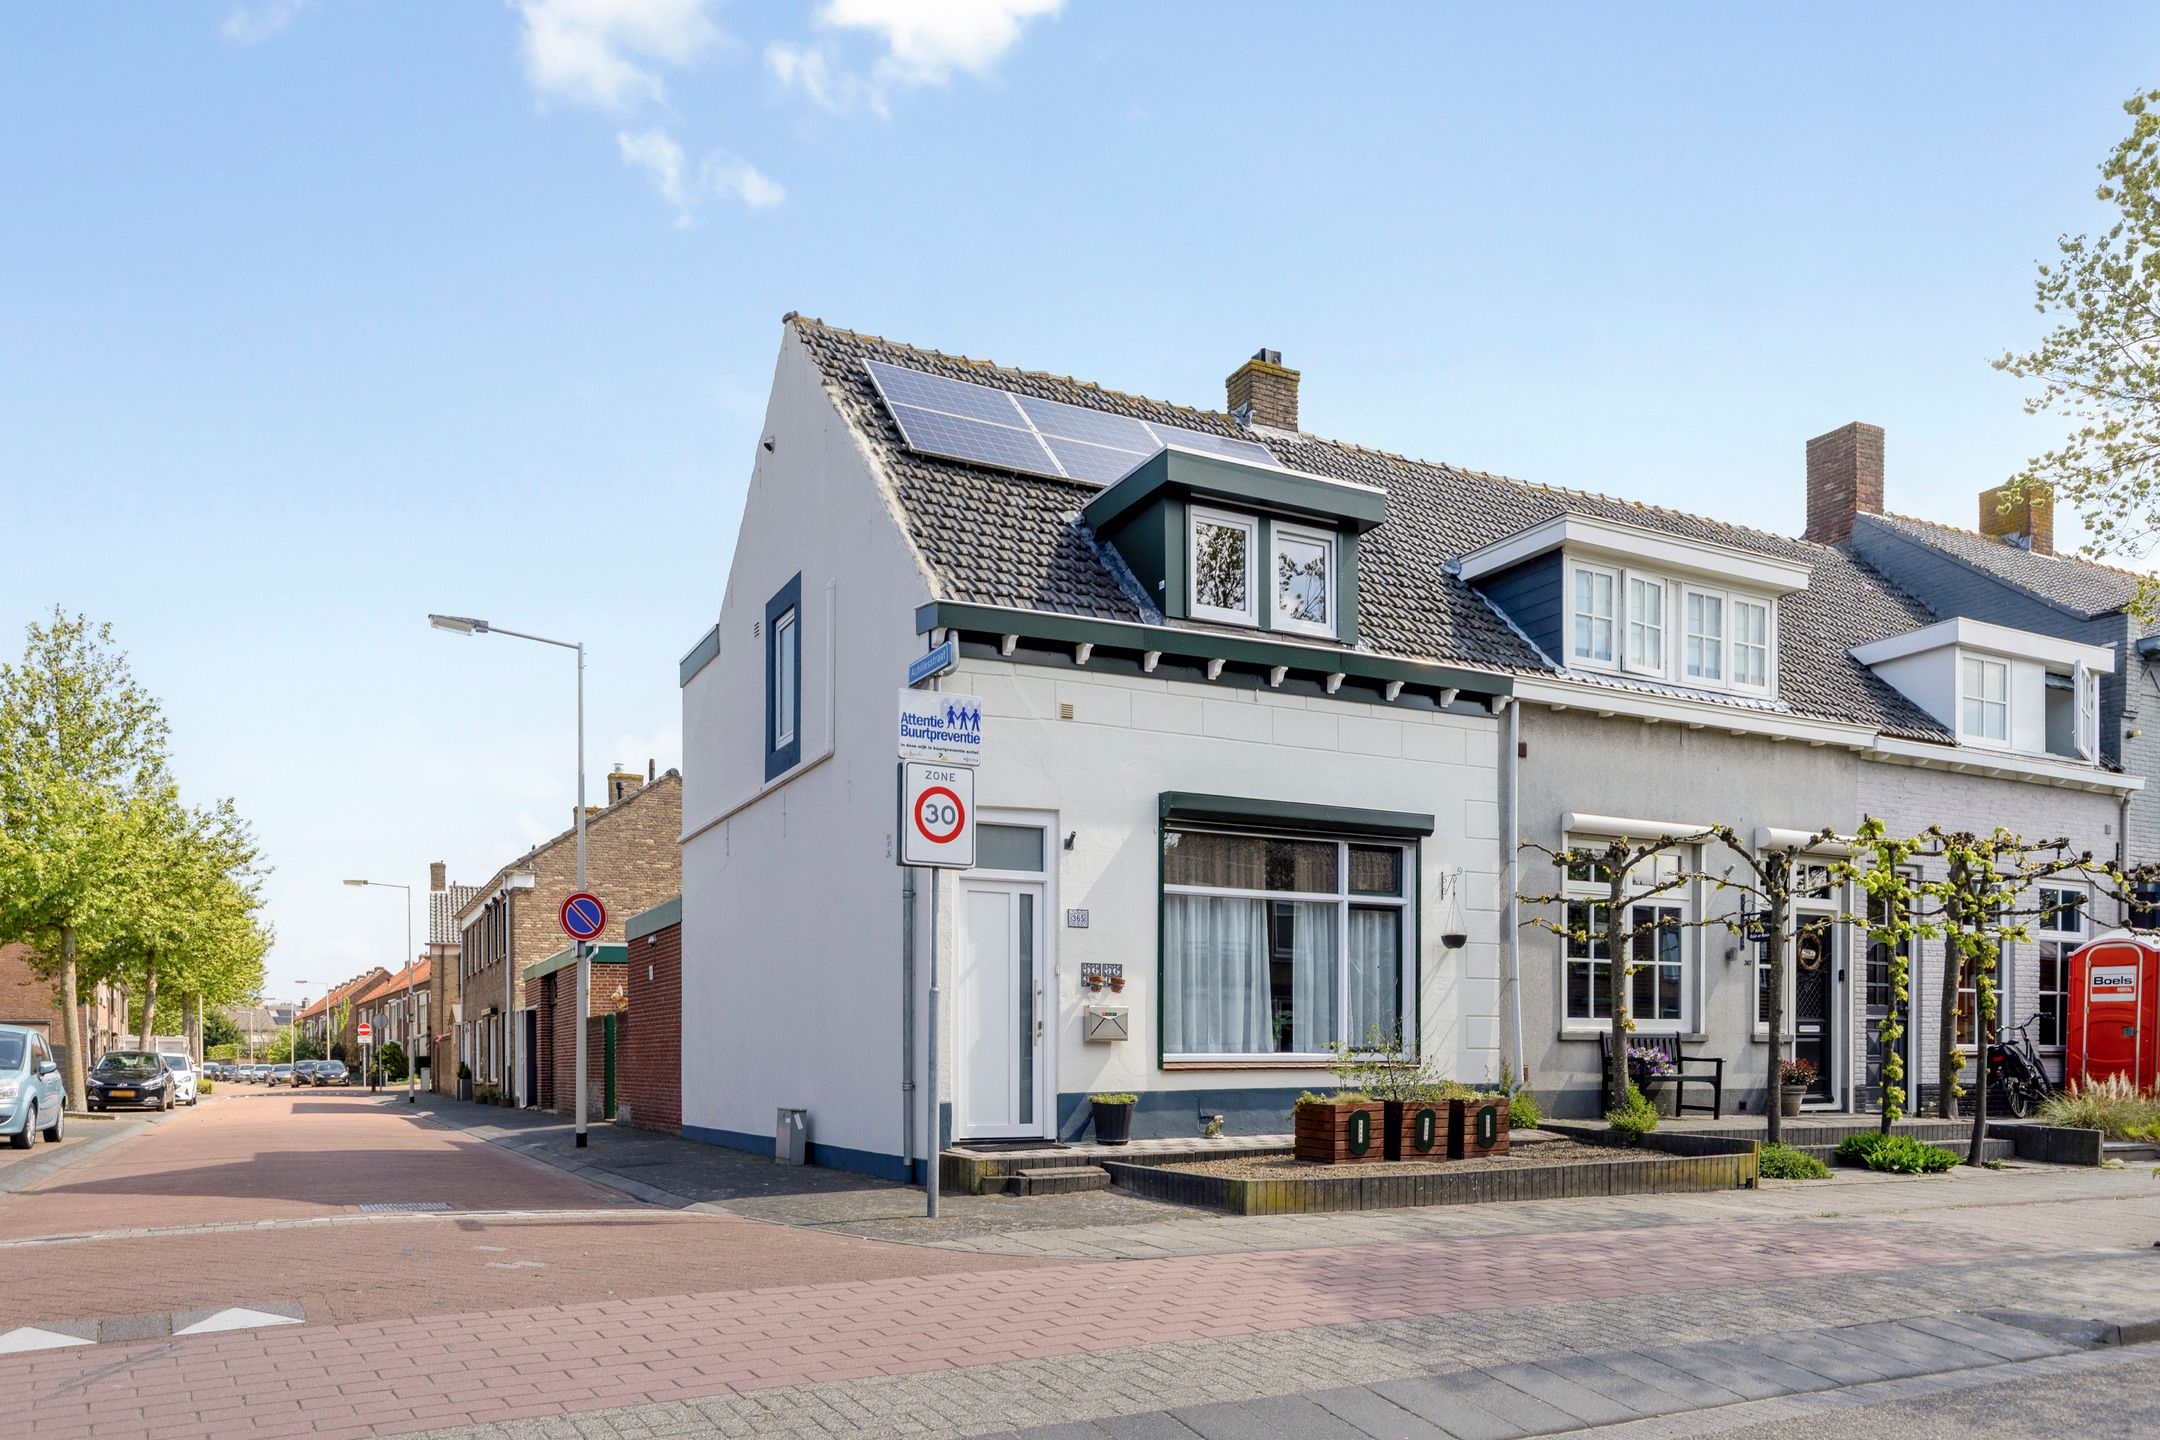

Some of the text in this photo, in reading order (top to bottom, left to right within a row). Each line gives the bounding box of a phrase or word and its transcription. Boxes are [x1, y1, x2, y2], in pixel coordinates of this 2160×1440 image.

[911, 649, 947, 676] Achillesstraat
[901, 712, 944, 728] Attentie
[901, 725, 980, 744] Buurtpreventie
[925, 770, 956, 782] ZONE
[925, 803, 956, 825] 30
[1071, 914, 1085, 922] 365
[2093, 976, 2133, 985] Boels
